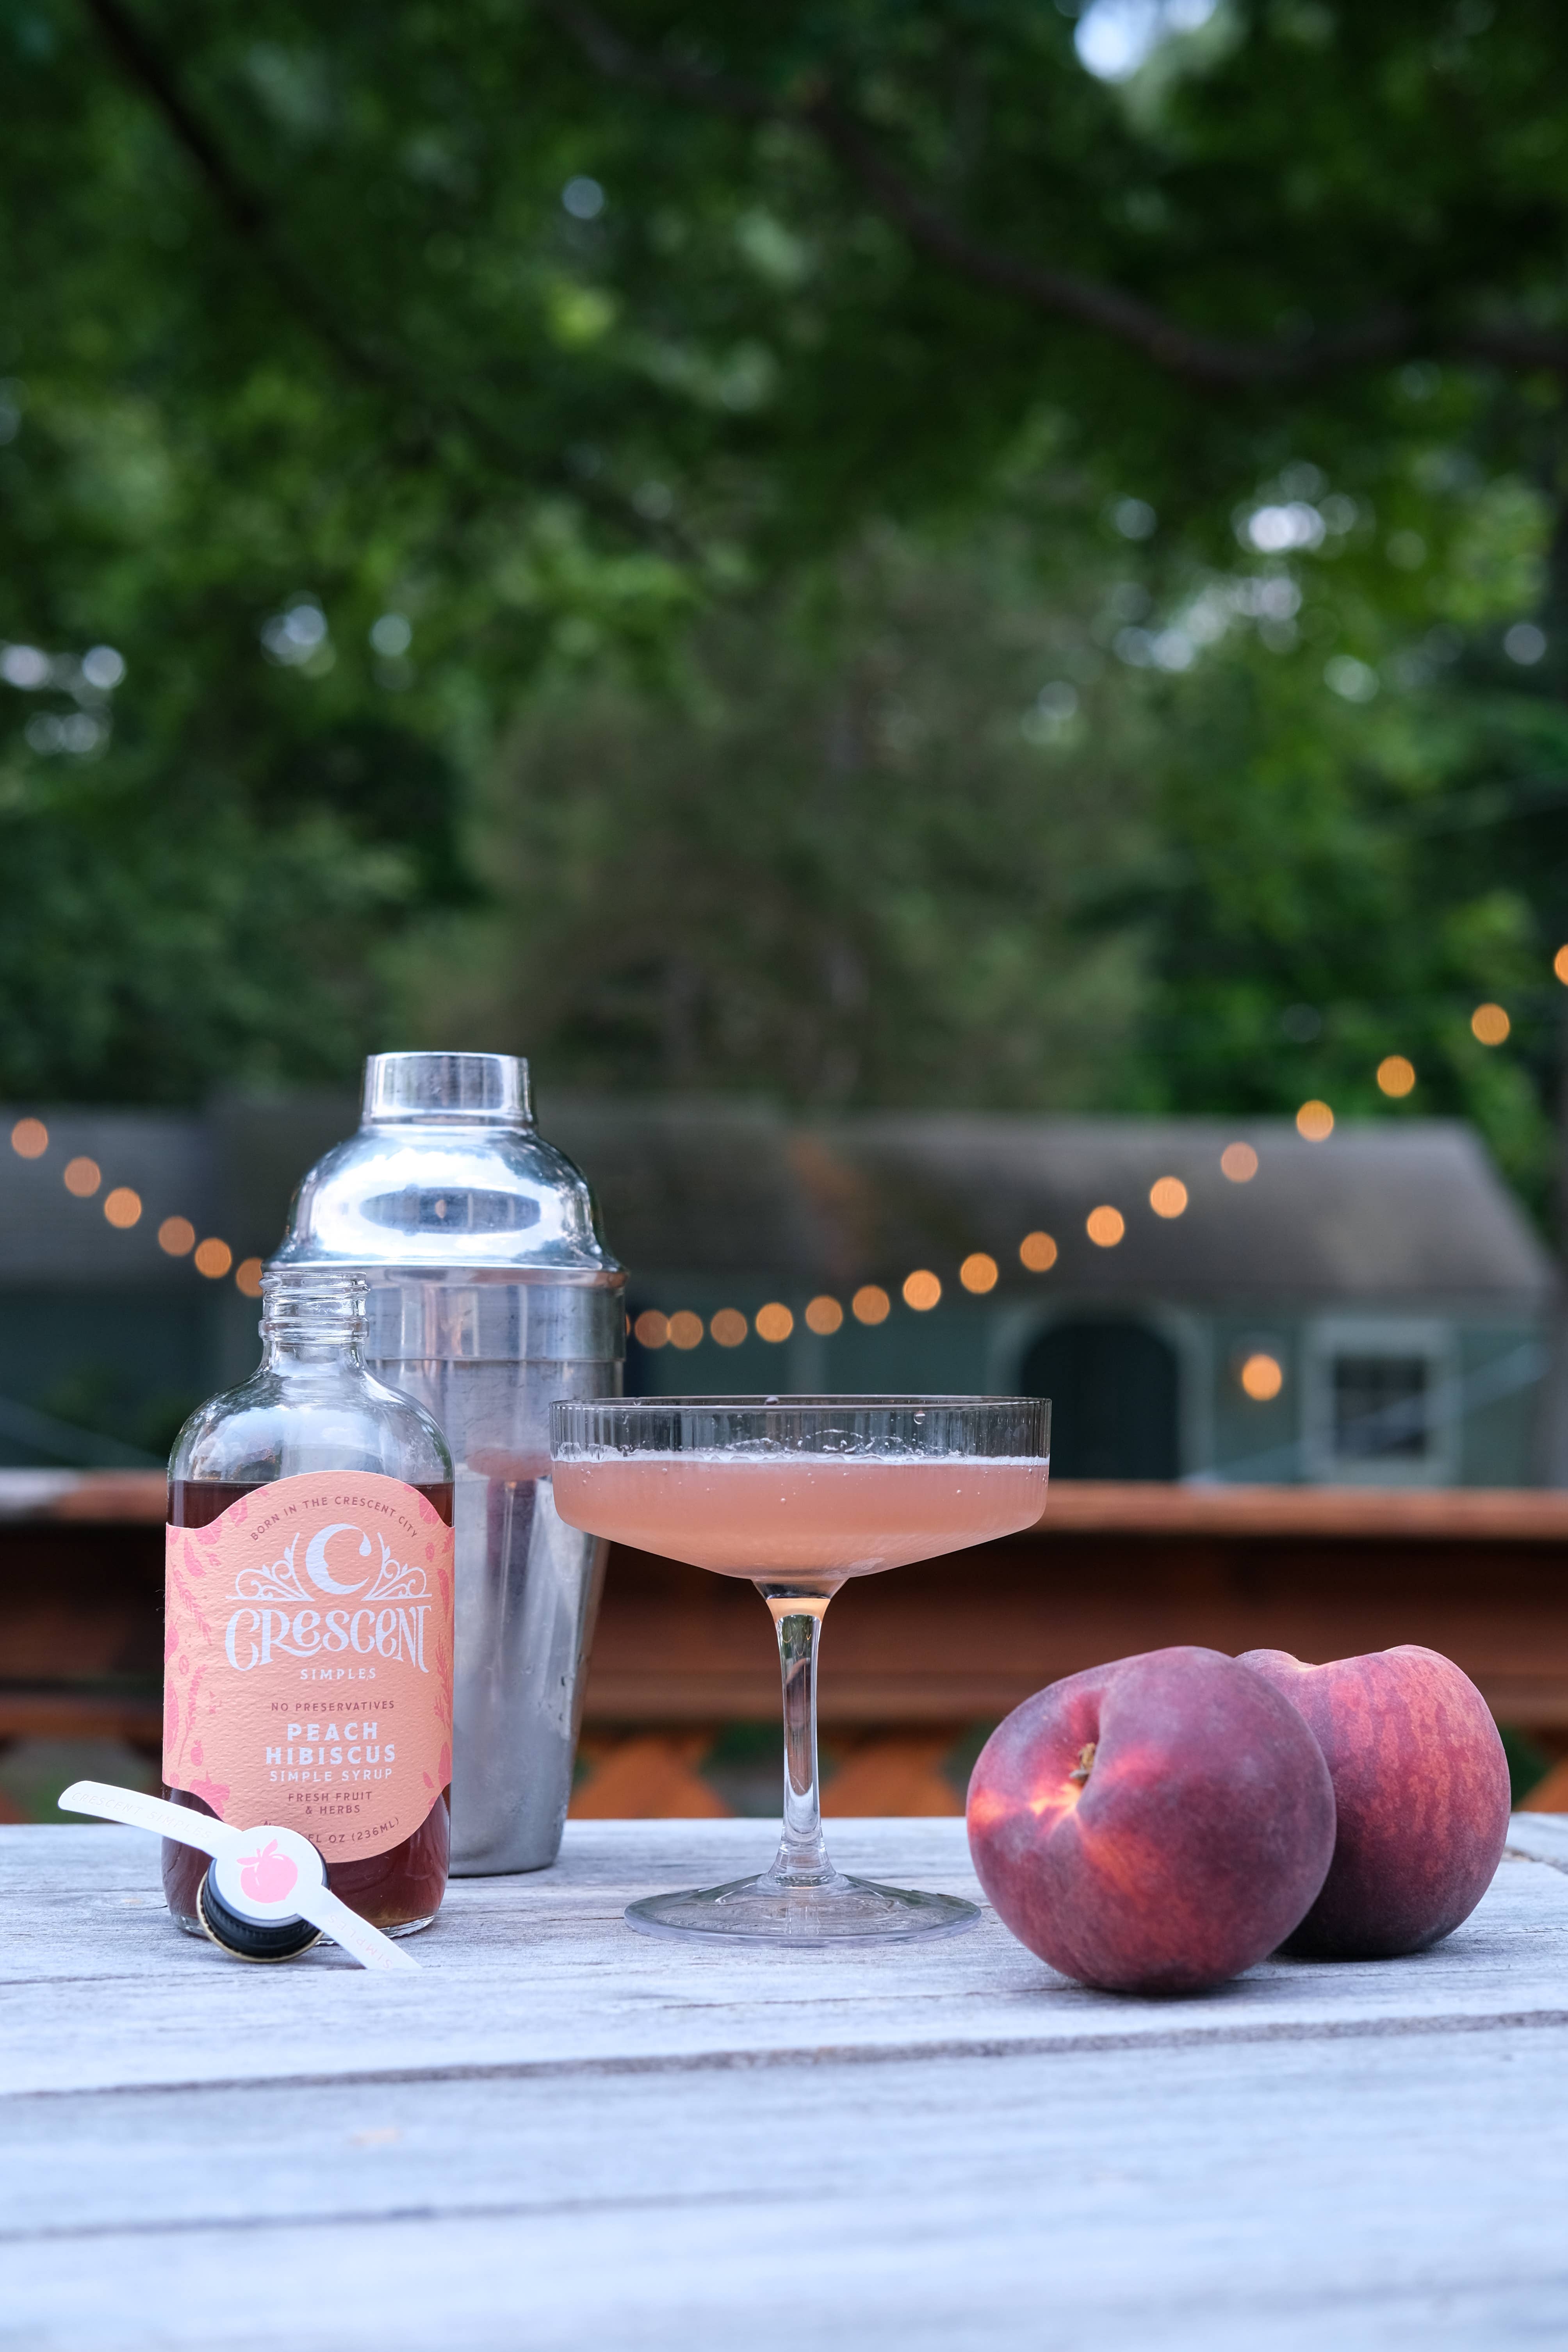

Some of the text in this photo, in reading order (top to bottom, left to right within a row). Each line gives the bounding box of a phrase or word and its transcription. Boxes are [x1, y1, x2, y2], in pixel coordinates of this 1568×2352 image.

[250, 1496, 417, 1541] BORN IN THE CRESCENT CITY
[300, 1668, 376, 1680] SIMPLES
[271, 1700, 394, 1712] NO PRESERVATIVES
[287, 1722, 378, 1741] PEACH
[265, 1744, 395, 1765] HIBISCUS
[270, 1768, 392, 1782] SIMPLE SYRUP
[289, 1791, 372, 1802] FRESH FRUIT
[71, 1793, 212, 1839] CRESCENT SIMPLES
[320, 1805, 360, 1814] HERBS
[329, 1834, 345, 1843] OZ
[352, 1817, 399, 1842] (236ML)
[328, 1914, 393, 1969] SIMPLES
